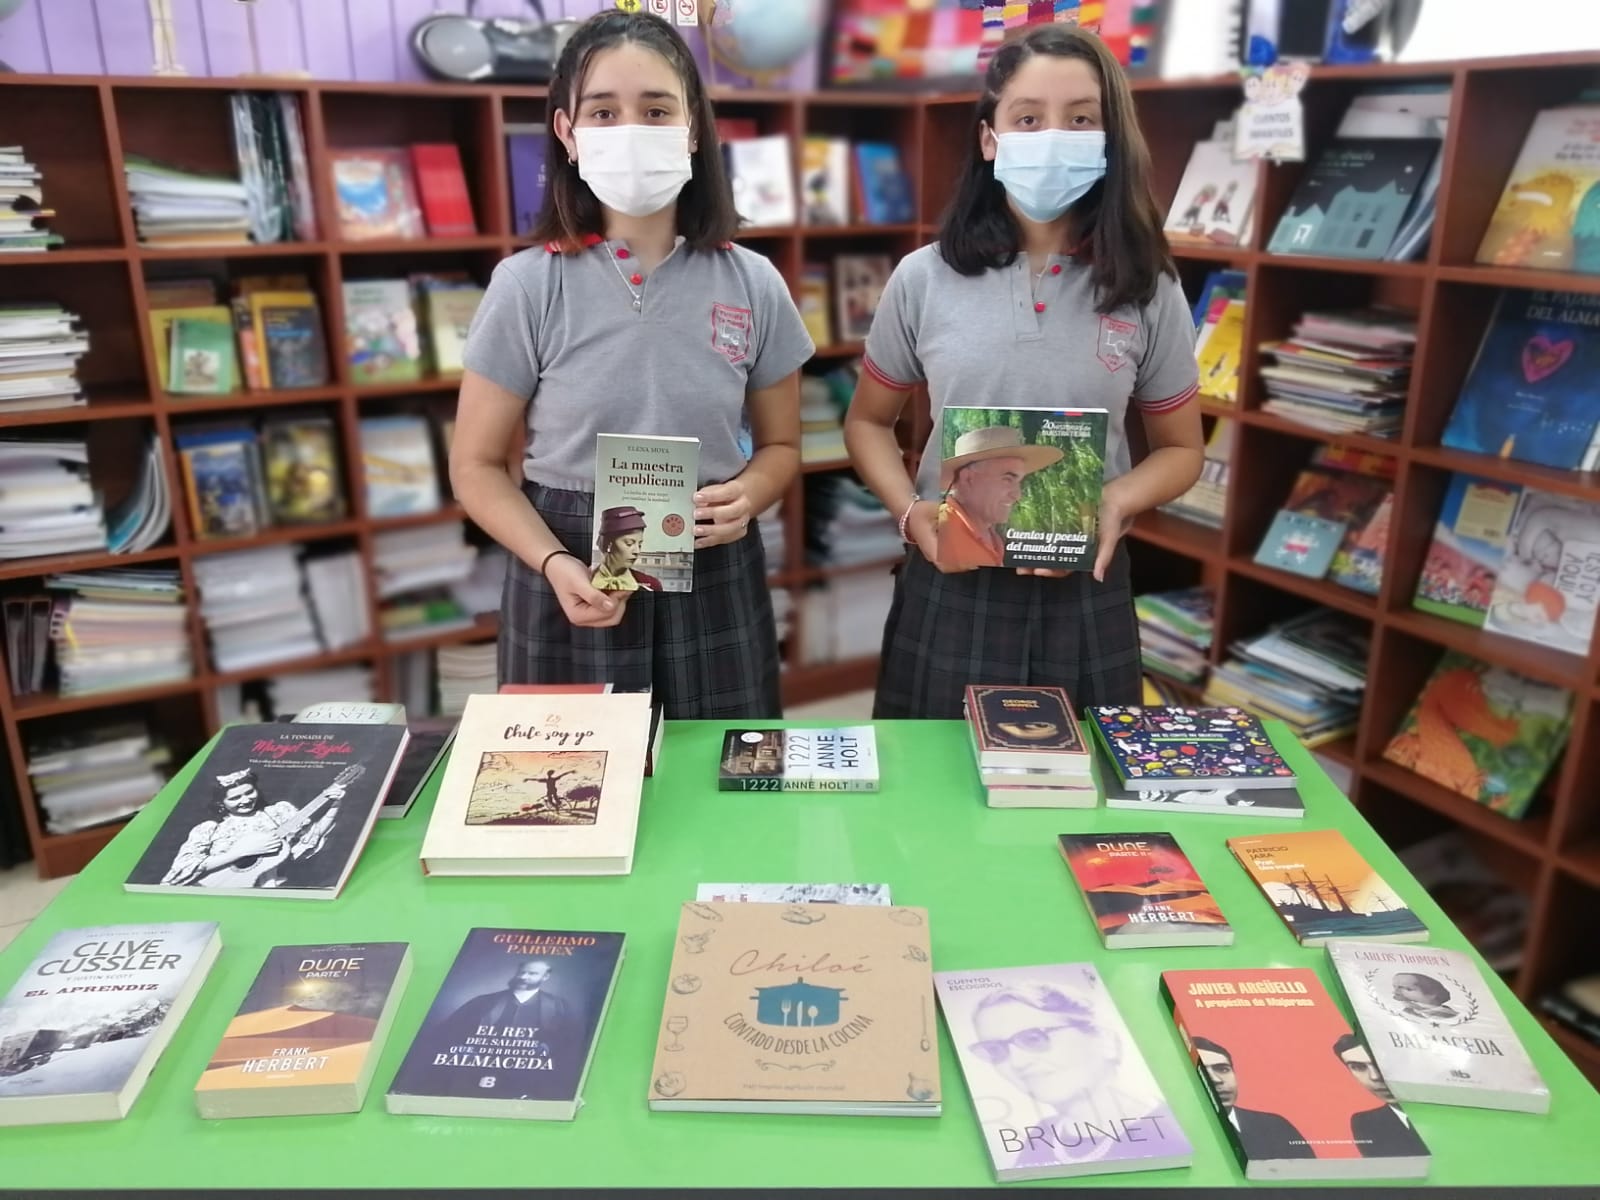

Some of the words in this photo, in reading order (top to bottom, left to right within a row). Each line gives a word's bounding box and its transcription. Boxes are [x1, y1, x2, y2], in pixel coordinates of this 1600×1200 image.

[611, 457, 628, 469] La
[631, 460, 684, 473] maestra
[608, 473, 685, 487] republicana
[1006, 527, 1046, 540] Cuentos
[1045, 532, 1053, 543] y
[1053, 531, 1088, 543] poesía
[1006, 541, 1021, 551] del
[1022, 543, 1058, 553] mundo
[1058, 544, 1087, 555] rural
[305, 711, 385, 720] DANTE
[504, 723, 542, 740] Chile
[545, 729, 570, 745] soy
[574, 729, 594, 746] yo
[250, 739, 303, 759] Margot
[304, 740, 354, 759] Loyola
[787, 735, 811, 769] 1222
[817, 735, 836, 770] ANNE
[840, 736, 860, 769] HOLT
[740, 779, 779, 790] 1222
[784, 781, 815, 789] ANNE
[819, 781, 848, 789] HOLT
[1095, 841, 1151, 852] DUNE
[1246, 846, 1289, 854] PATRICIO
[1143, 904, 1173, 912] FRANK
[1127, 911, 1197, 924] HERBERT
[493, 933, 596, 946] GUILLERMO
[72, 939, 165, 958] CLIVE
[506, 944, 575, 956] PARVEX
[36, 954, 182, 976] CUSSLER
[298, 957, 365, 972] DUNE
[729, 949, 873, 976] Chiloé
[1354, 951, 1397, 963] CARLOS
[1399, 953, 1451, 967] TROMBEN
[305, 970, 342, 978] PARTE
[946, 977, 991, 986] CUENTOS
[949, 982, 1003, 991] ESCOGIDOS
[1188, 982, 1237, 995] JAVIER
[1238, 980, 1308, 994] ARGÜELLO
[24, 990, 49, 998] EL
[56, 984, 160, 995] APRENDIZ
[1195, 998, 1204, 1008] A
[1204, 998, 1252, 1009] propósito
[1251, 998, 1266, 1007] de
[475, 1025, 498, 1037] EL
[502, 1026, 539, 1038] REY
[723, 1012, 775, 1051] CONTADO
[774, 1037, 812, 1055] DESDE
[812, 1036, 830, 1053] LA
[828, 1014, 874, 1048] COCINA
[465, 1037, 489, 1046] DEL
[489, 1038, 539, 1048] SALITRE
[272, 1047, 311, 1056] FRANK
[450, 1045, 474, 1054] QUE
[479, 1047, 536, 1056] DERROTÓ
[241, 1055, 329, 1073] HERBERT
[432, 1053, 554, 1070] BALMACEDA
[998, 1115, 1167, 1153] BRUNET
